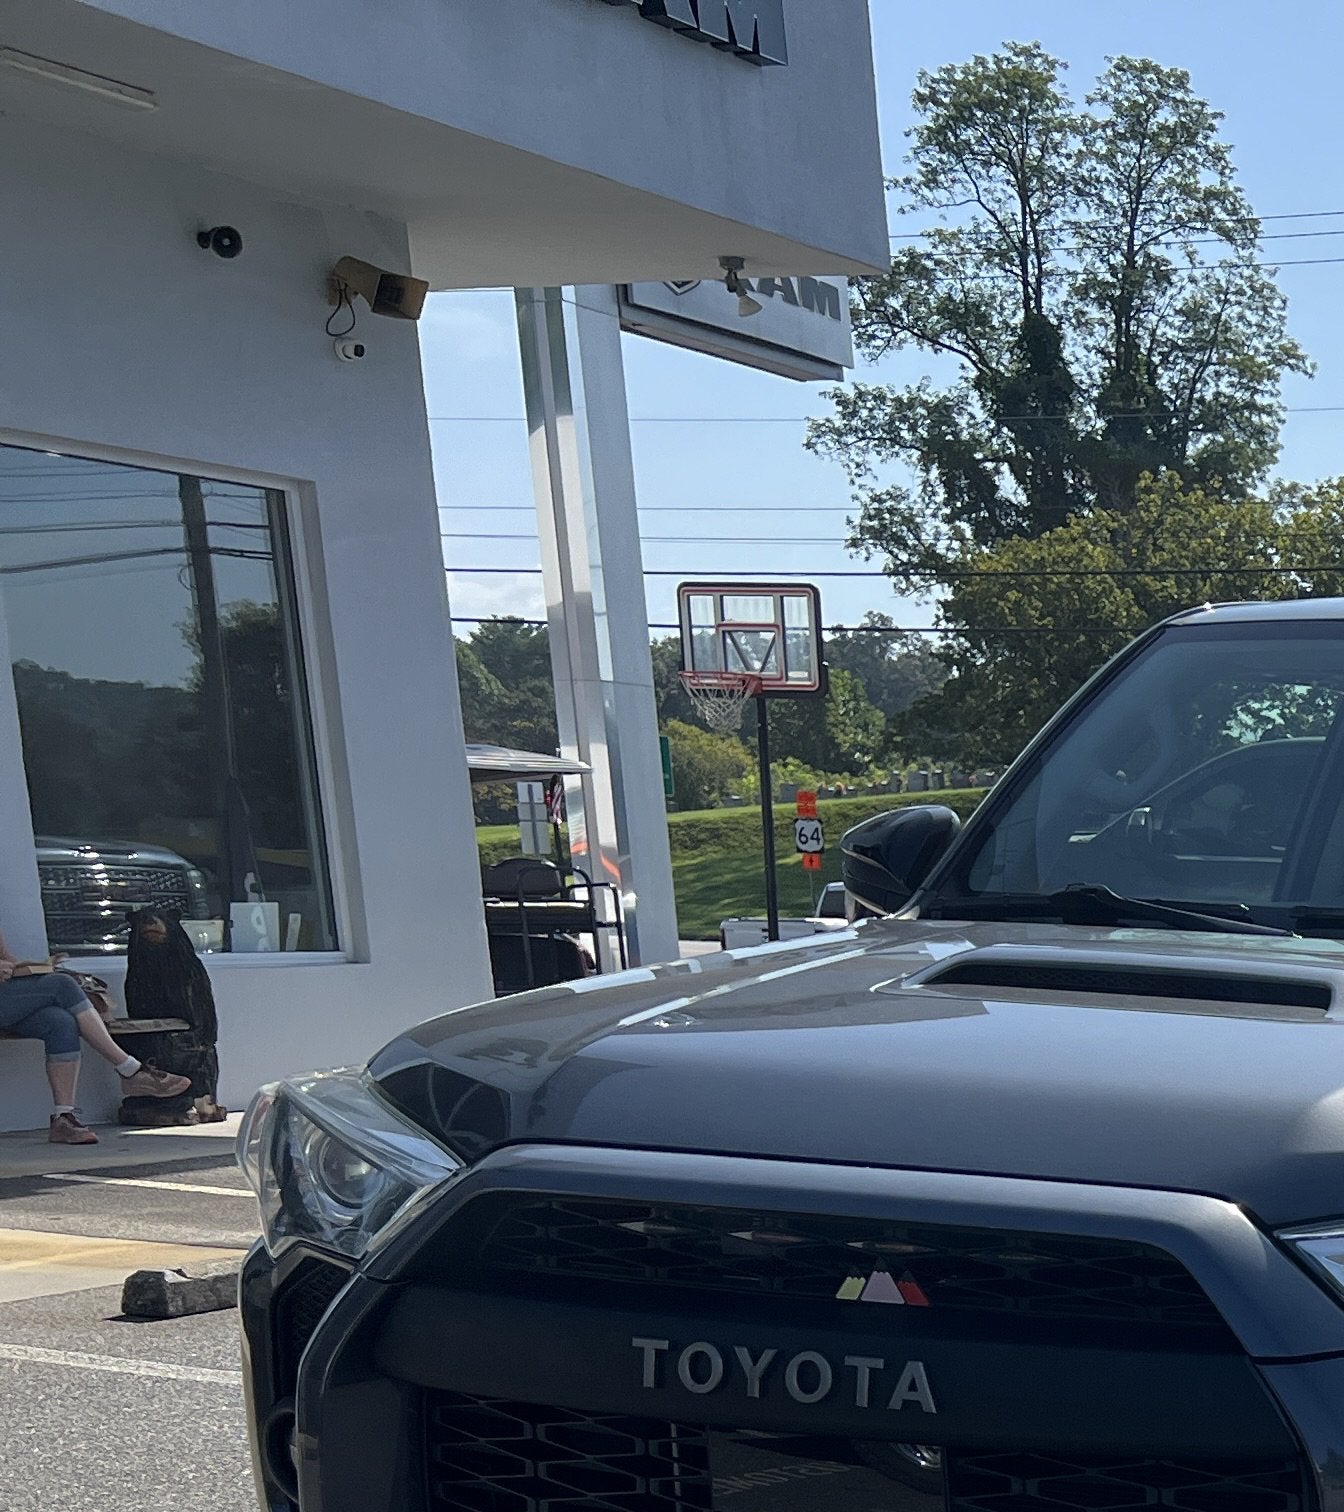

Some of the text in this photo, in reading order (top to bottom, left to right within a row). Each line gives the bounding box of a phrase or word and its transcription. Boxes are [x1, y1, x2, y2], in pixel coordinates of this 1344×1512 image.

[738, 276, 841, 321] AM
[798, 826, 821, 846] 64
[632, 1336, 937, 1413] TOYOTA
